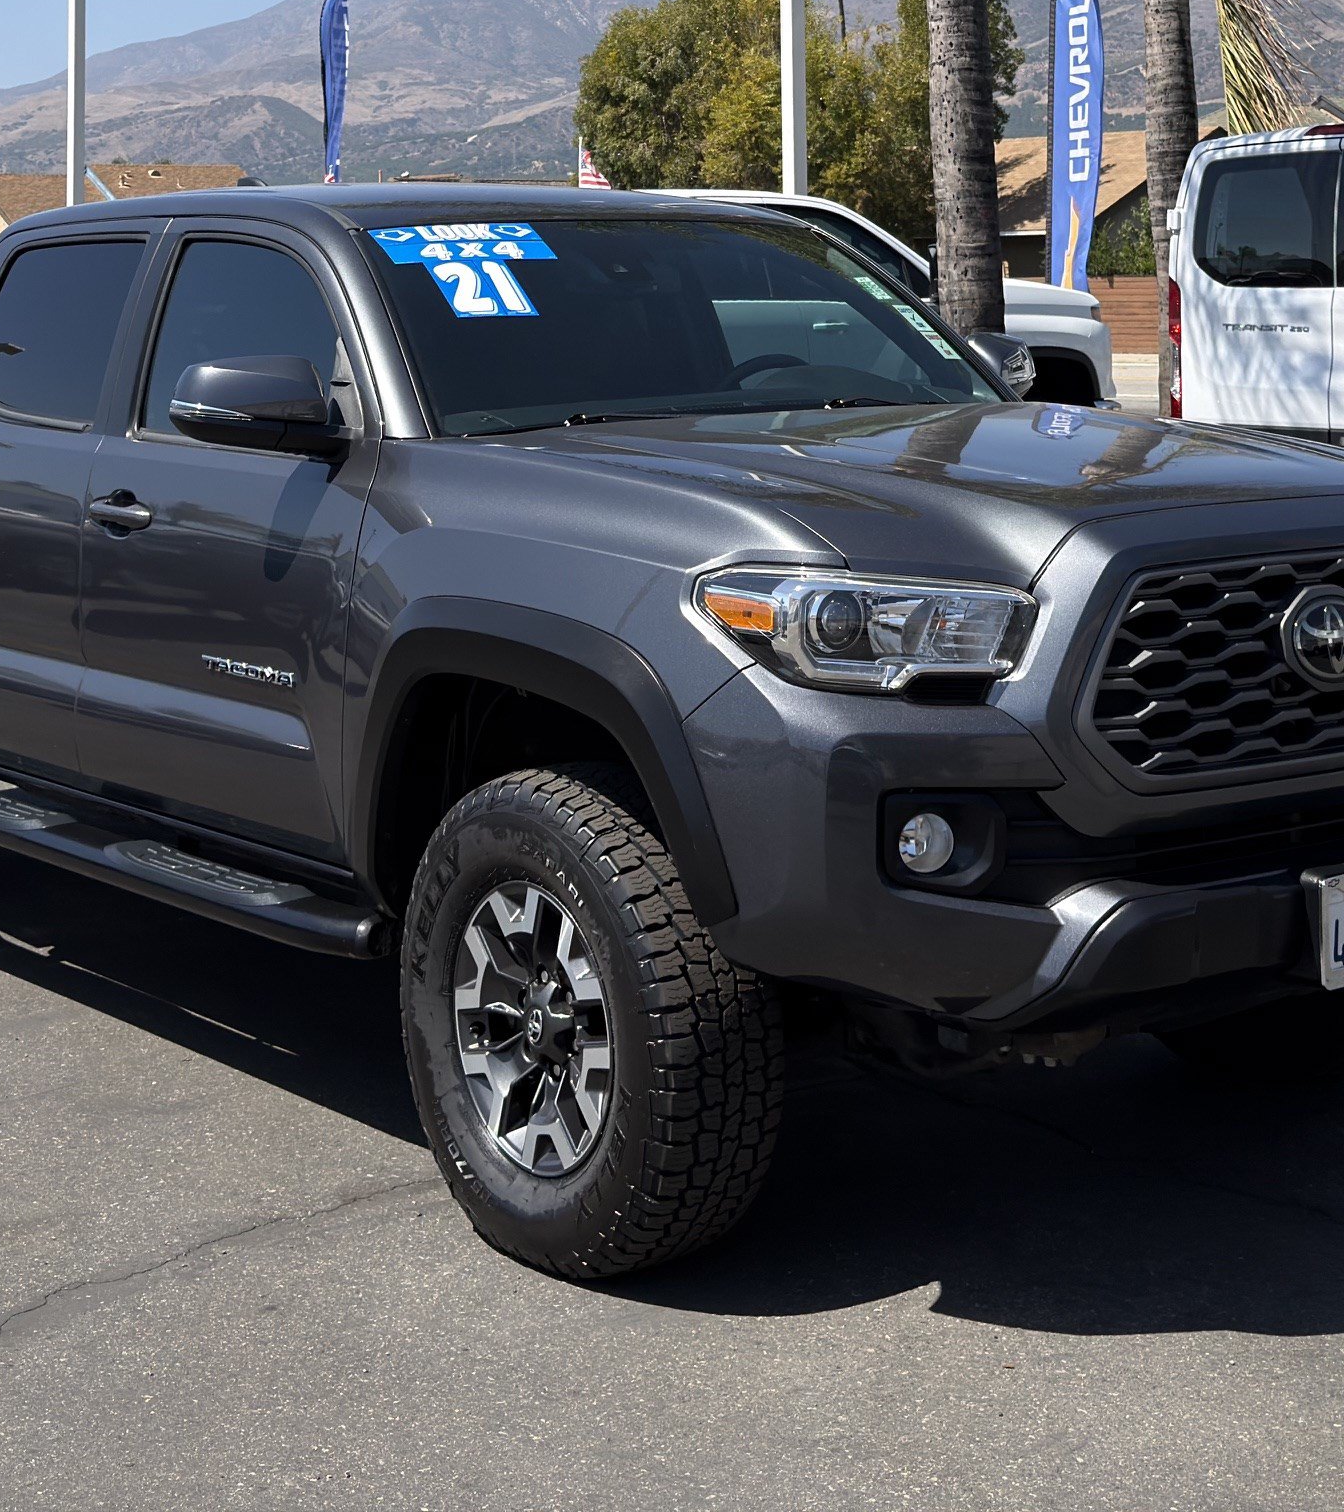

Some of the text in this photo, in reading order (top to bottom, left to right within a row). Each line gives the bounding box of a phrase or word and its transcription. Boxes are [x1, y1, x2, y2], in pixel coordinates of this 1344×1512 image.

[414, 223, 502, 241] LOOK
[433, 261, 531, 315] 21
[1222, 323, 1288, 332] TRANSIT
[202, 655, 294, 688] TACOMA
